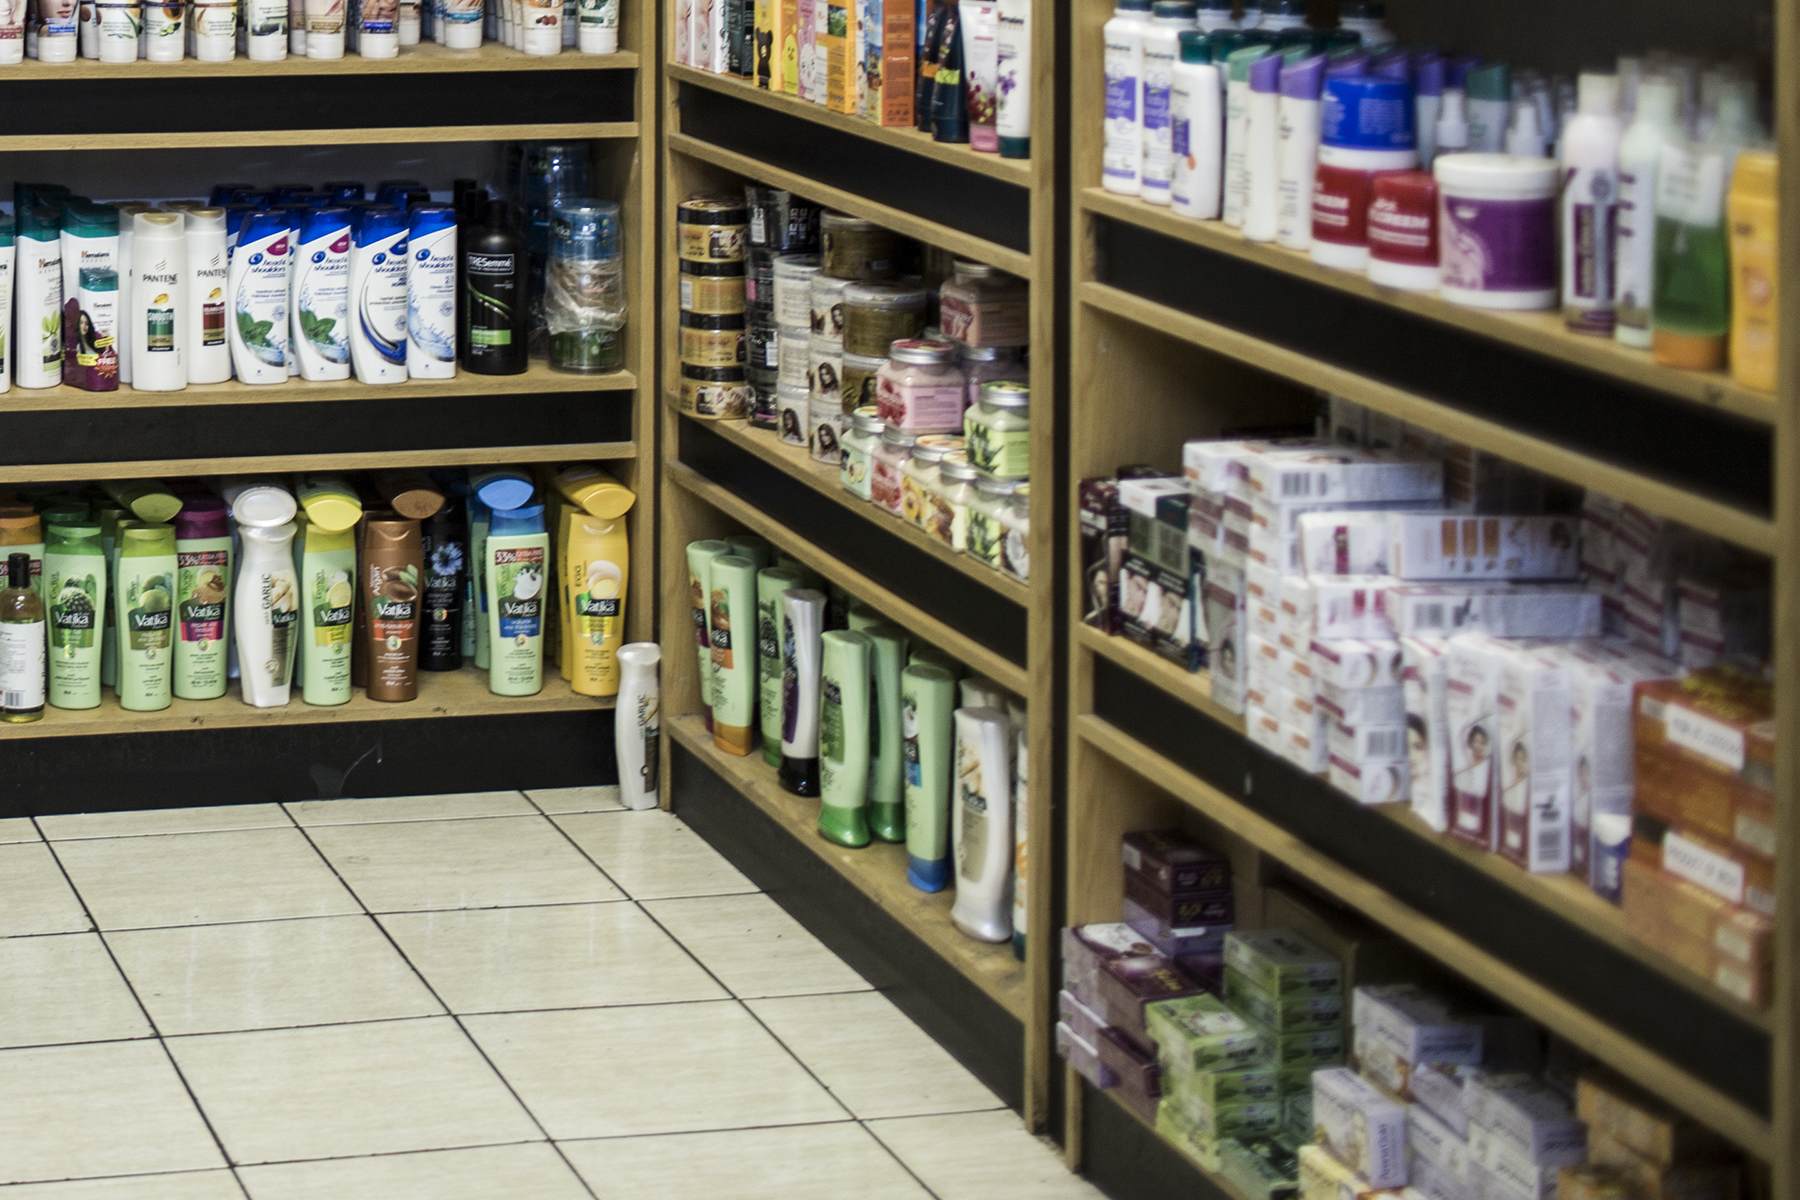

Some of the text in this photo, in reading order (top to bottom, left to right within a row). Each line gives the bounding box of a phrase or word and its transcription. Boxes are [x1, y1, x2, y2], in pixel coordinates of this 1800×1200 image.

[418, 262, 454, 270] shoulders
[143, 274, 178, 283] PANTENE
[198, 268, 227, 278] PANTENE
[97, 356, 117, 365] FREE
[178, 554, 198, 567] 33%
[495, 551, 517, 562] 33%
[188, 605, 221, 619] Vatika
[377, 601, 412, 618] Vatika
[504, 602, 537, 615] Vatika
[580, 599, 615, 612] Vatika
[55, 611, 91, 625] Vatika
[135, 614, 169, 627] Vatika
[320, 608, 350, 622] Vatika
